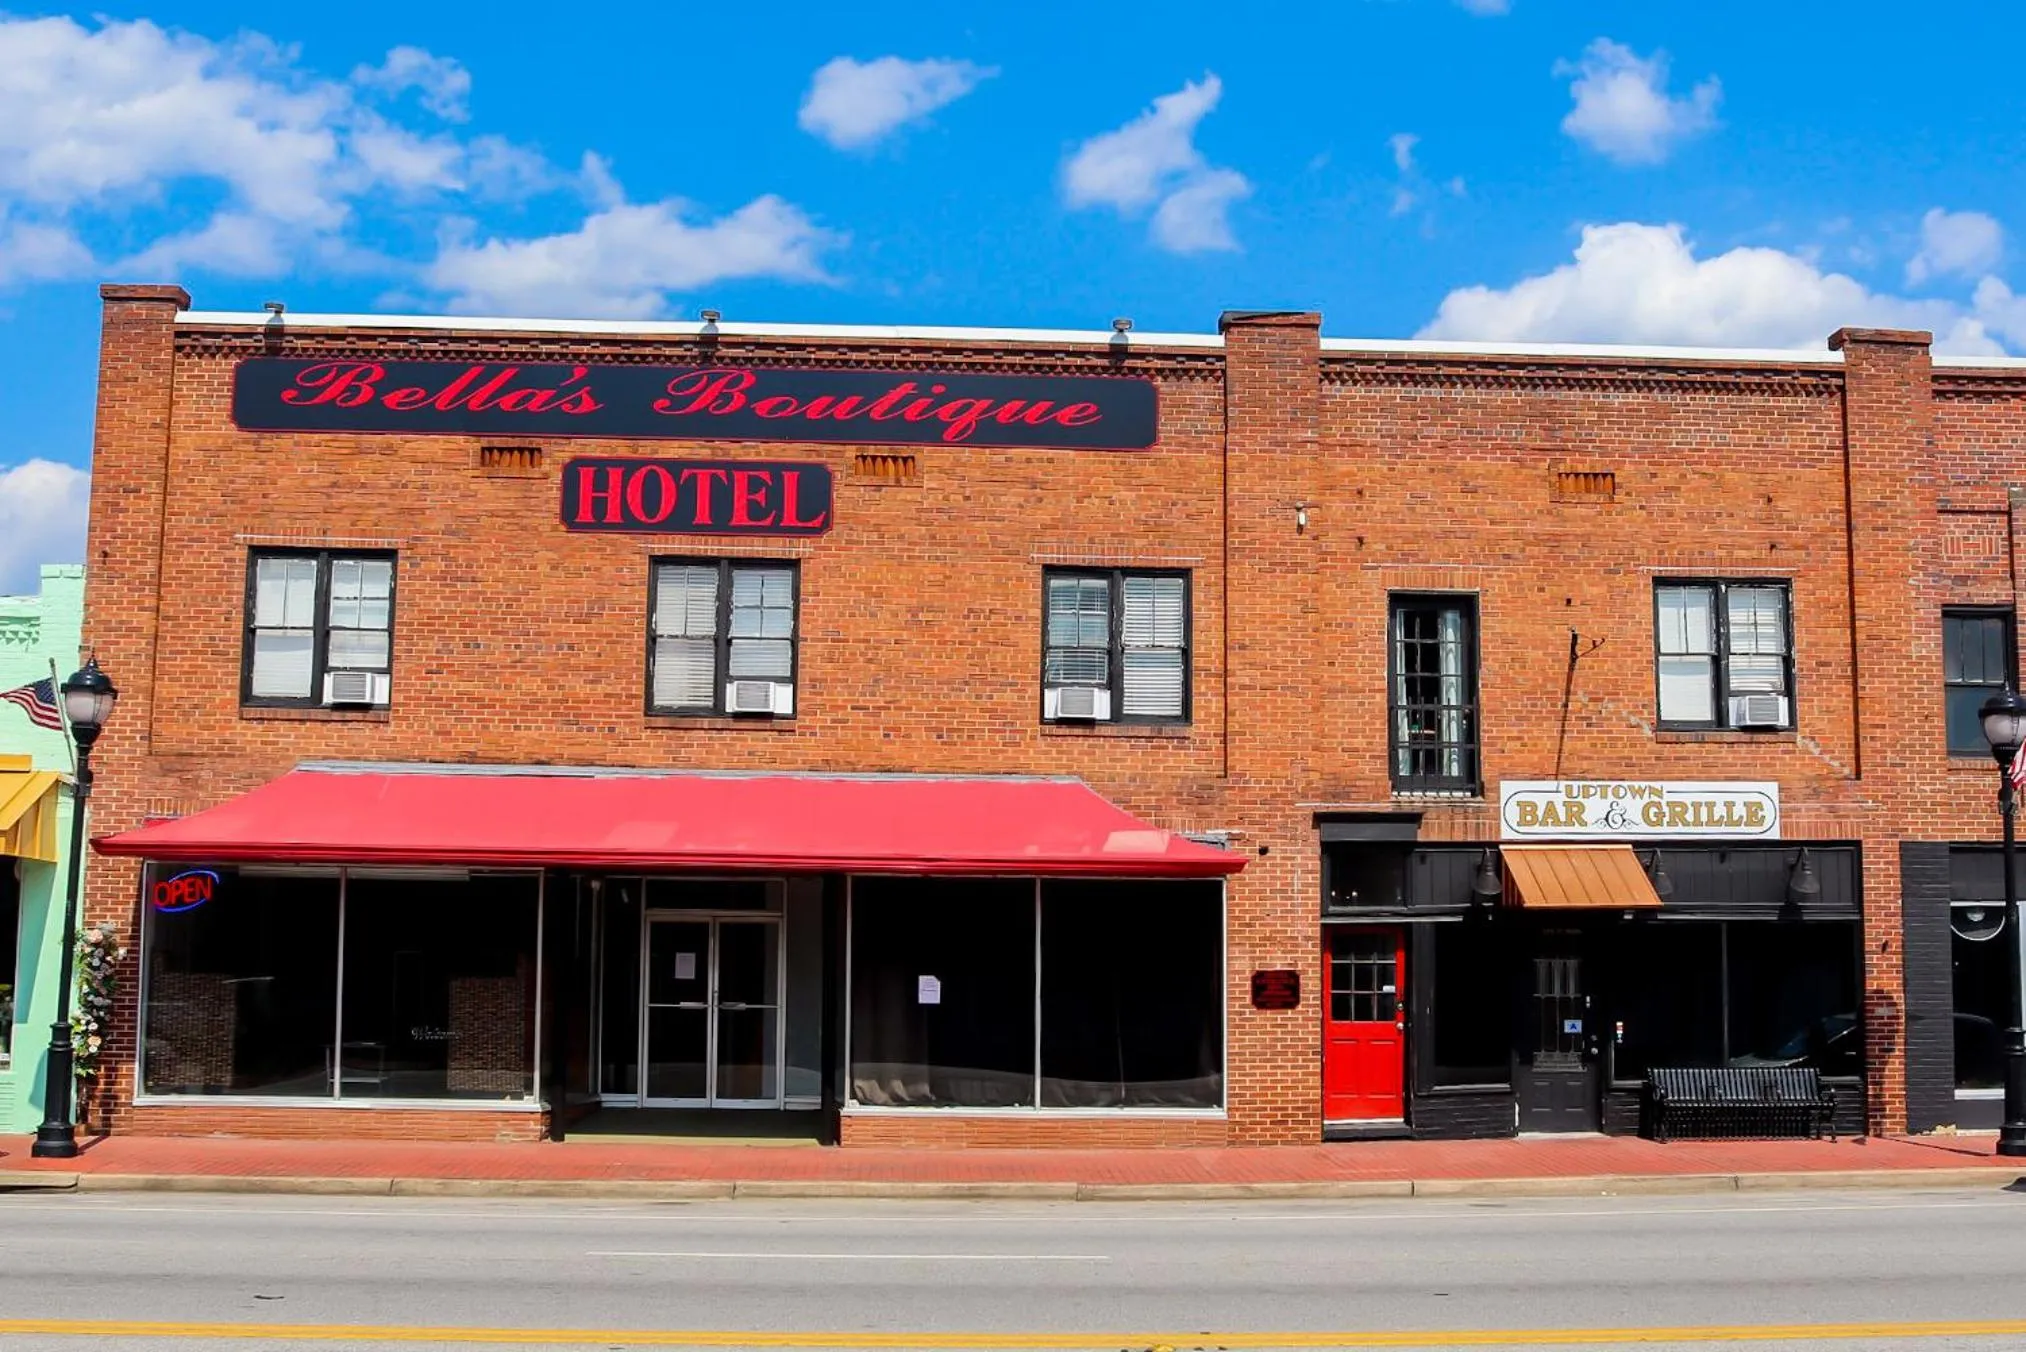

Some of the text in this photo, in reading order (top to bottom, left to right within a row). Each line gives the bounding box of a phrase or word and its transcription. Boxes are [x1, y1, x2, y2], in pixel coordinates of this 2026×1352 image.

[281, 361, 1103, 443] Bella's Boutique
[574, 464, 827, 529] HOTEL
[1564, 784, 1665, 800] UPTOWN
[1516, 800, 1766, 830] BAR & GRILLE
[152, 876, 212, 906] OPEN
